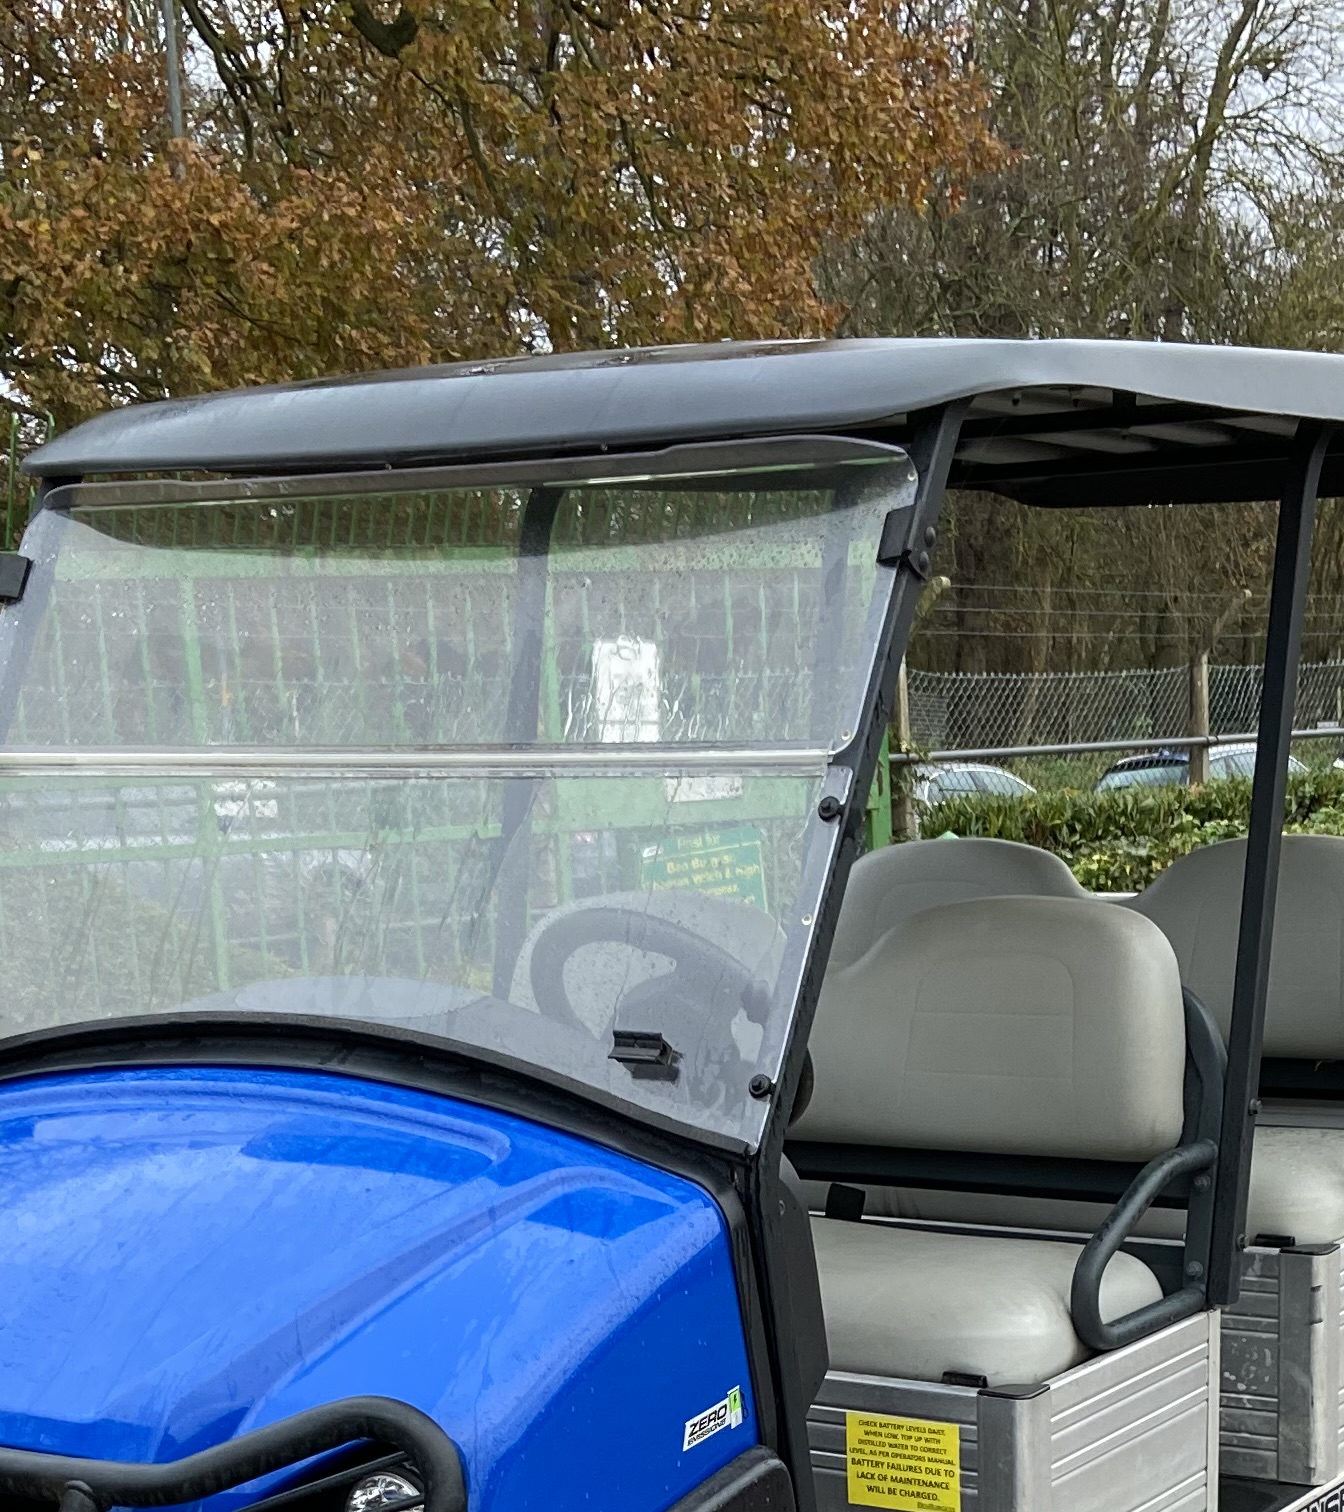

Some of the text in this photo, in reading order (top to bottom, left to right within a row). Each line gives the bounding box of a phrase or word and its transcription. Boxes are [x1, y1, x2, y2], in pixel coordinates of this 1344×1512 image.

[688, 1404, 727, 1438] ZERO
[879, 1422, 904, 1431] BATTERY
[906, 1425, 926, 1433] LEVELS
[864, 1429, 882, 1437] WHEN
[924, 1436, 941, 1445] WITH
[888, 1442, 908, 1450] WATER
[920, 1446, 947, 1455] CORRECT
[851, 1457, 955, 1478] BATTERY FAILURES DUE TO
[856, 1470, 875, 1480] LACK
[890, 1475, 950, 1491] MAINTENANCE
[866, 1484, 941, 1502] WILL BE CHARGED.
